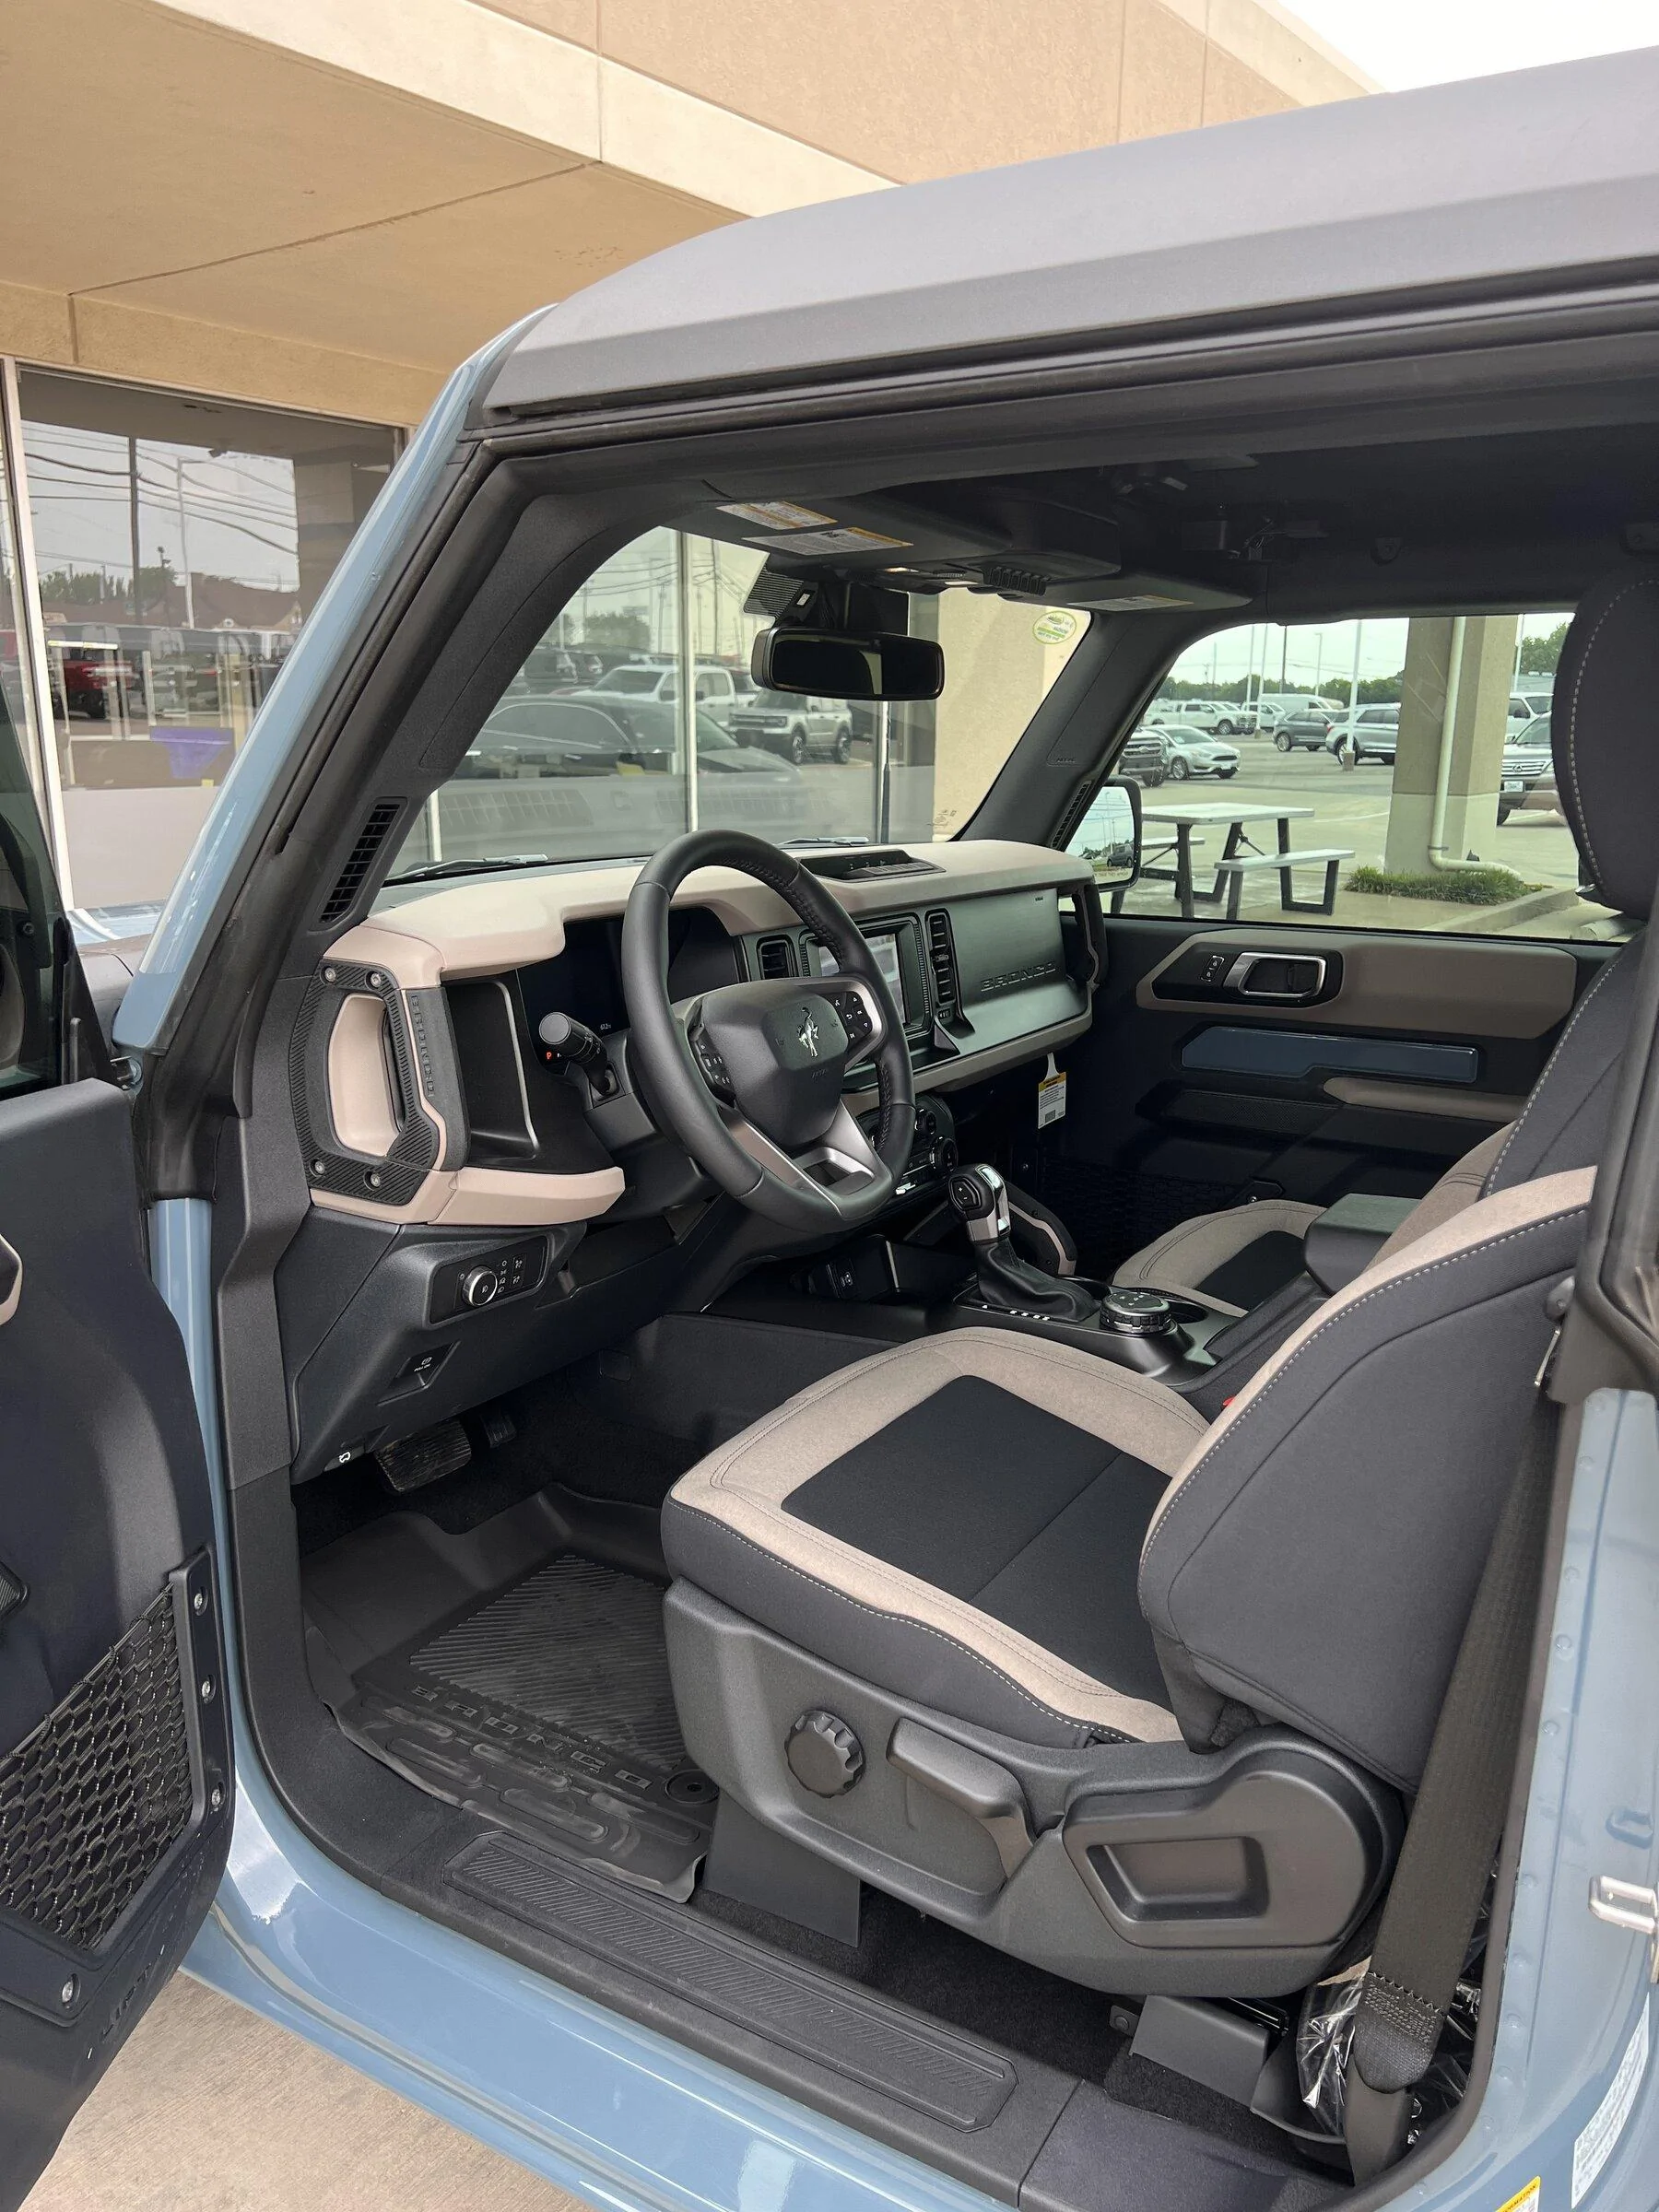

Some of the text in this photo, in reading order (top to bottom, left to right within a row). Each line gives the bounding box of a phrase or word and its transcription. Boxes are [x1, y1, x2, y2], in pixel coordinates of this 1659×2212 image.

[980, 961, 1056, 992] BRONCO
[410, 994, 435, 1098] BRONCO
[410, 1685, 653, 1791] BRONCO
